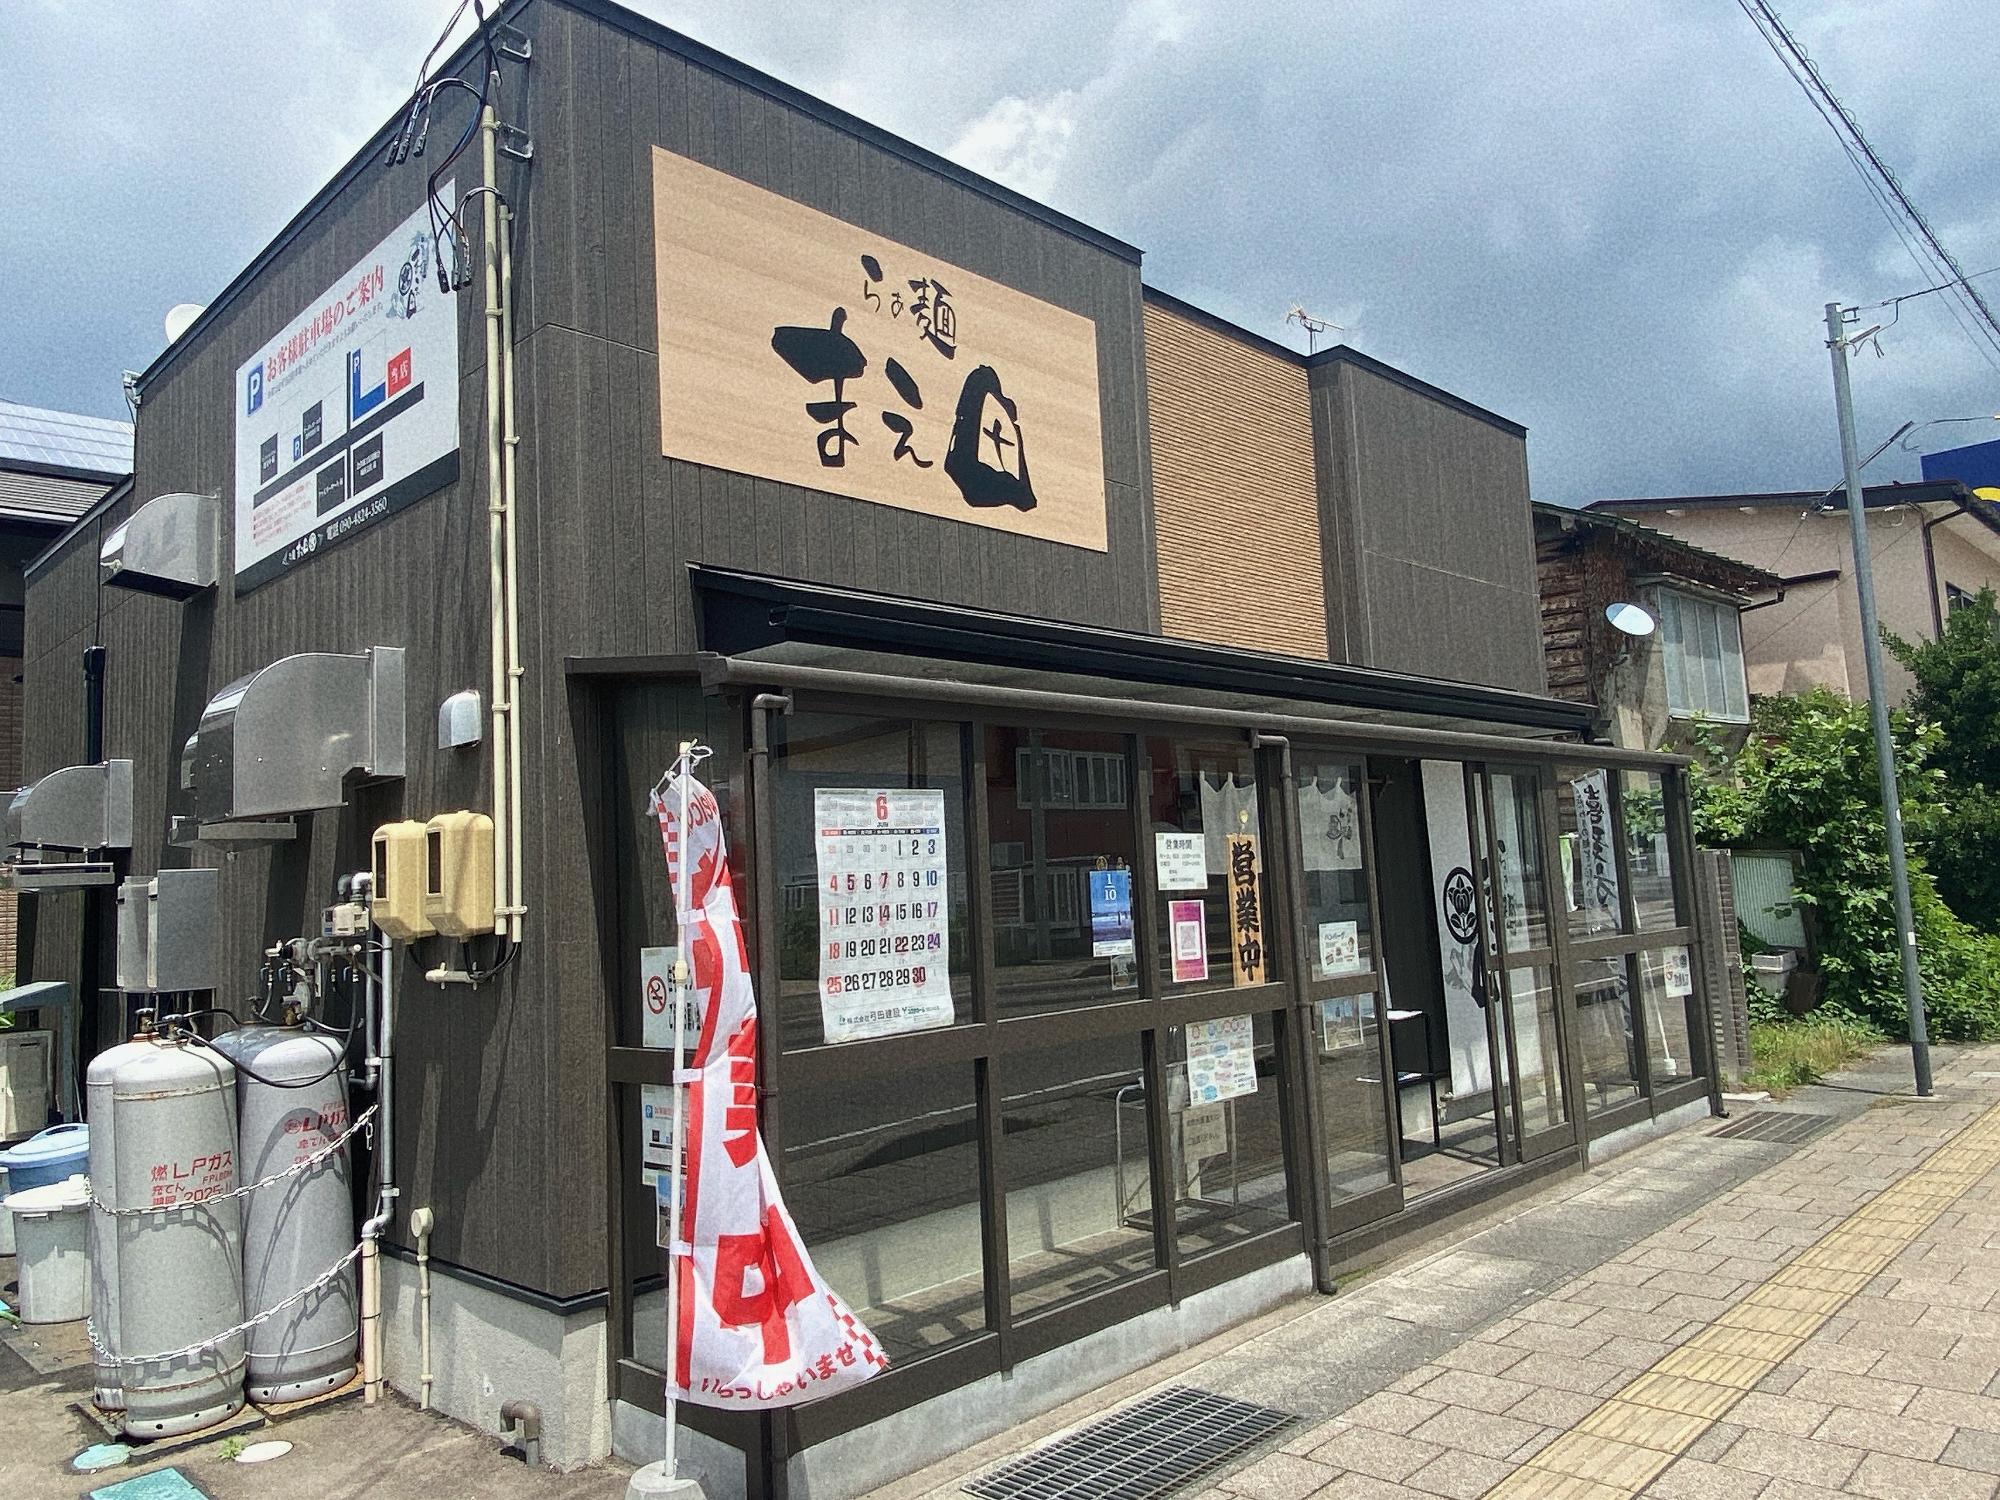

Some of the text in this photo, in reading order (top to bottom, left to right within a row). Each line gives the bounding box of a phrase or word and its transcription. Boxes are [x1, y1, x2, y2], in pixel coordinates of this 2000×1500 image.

[861, 254, 957, 360] らぁ麺
[251, 372, 261, 410] P
[771, 307, 1037, 512] まえ田
[875, 796, 888, 820] 6
[911, 839, 919, 856] 2
[928, 839, 936, 854] 3
[1165, 839, 1193, 850] 営業時間
[830, 870, 938, 891] 4 5 6 7 8 9 10
[1104, 889, 1117, 900] 10
[829, 901, 938, 926] 11 12 13 14 15 16 17
[1231, 840, 1261, 982] 営業中
[829, 933, 941, 960] 18 19 20 21 22 23 24
[827, 976, 842, 995] 25
[844, 974, 860, 992] 26
[861, 972, 876, 990] 27
[879, 970, 894, 987] 28
[896, 968, 910, 986] 29
[912, 966, 926, 984] 30
[173, 1149, 232, 1179] LPガス
[701, 1343, 857, 1401] いらっしゃいませ
